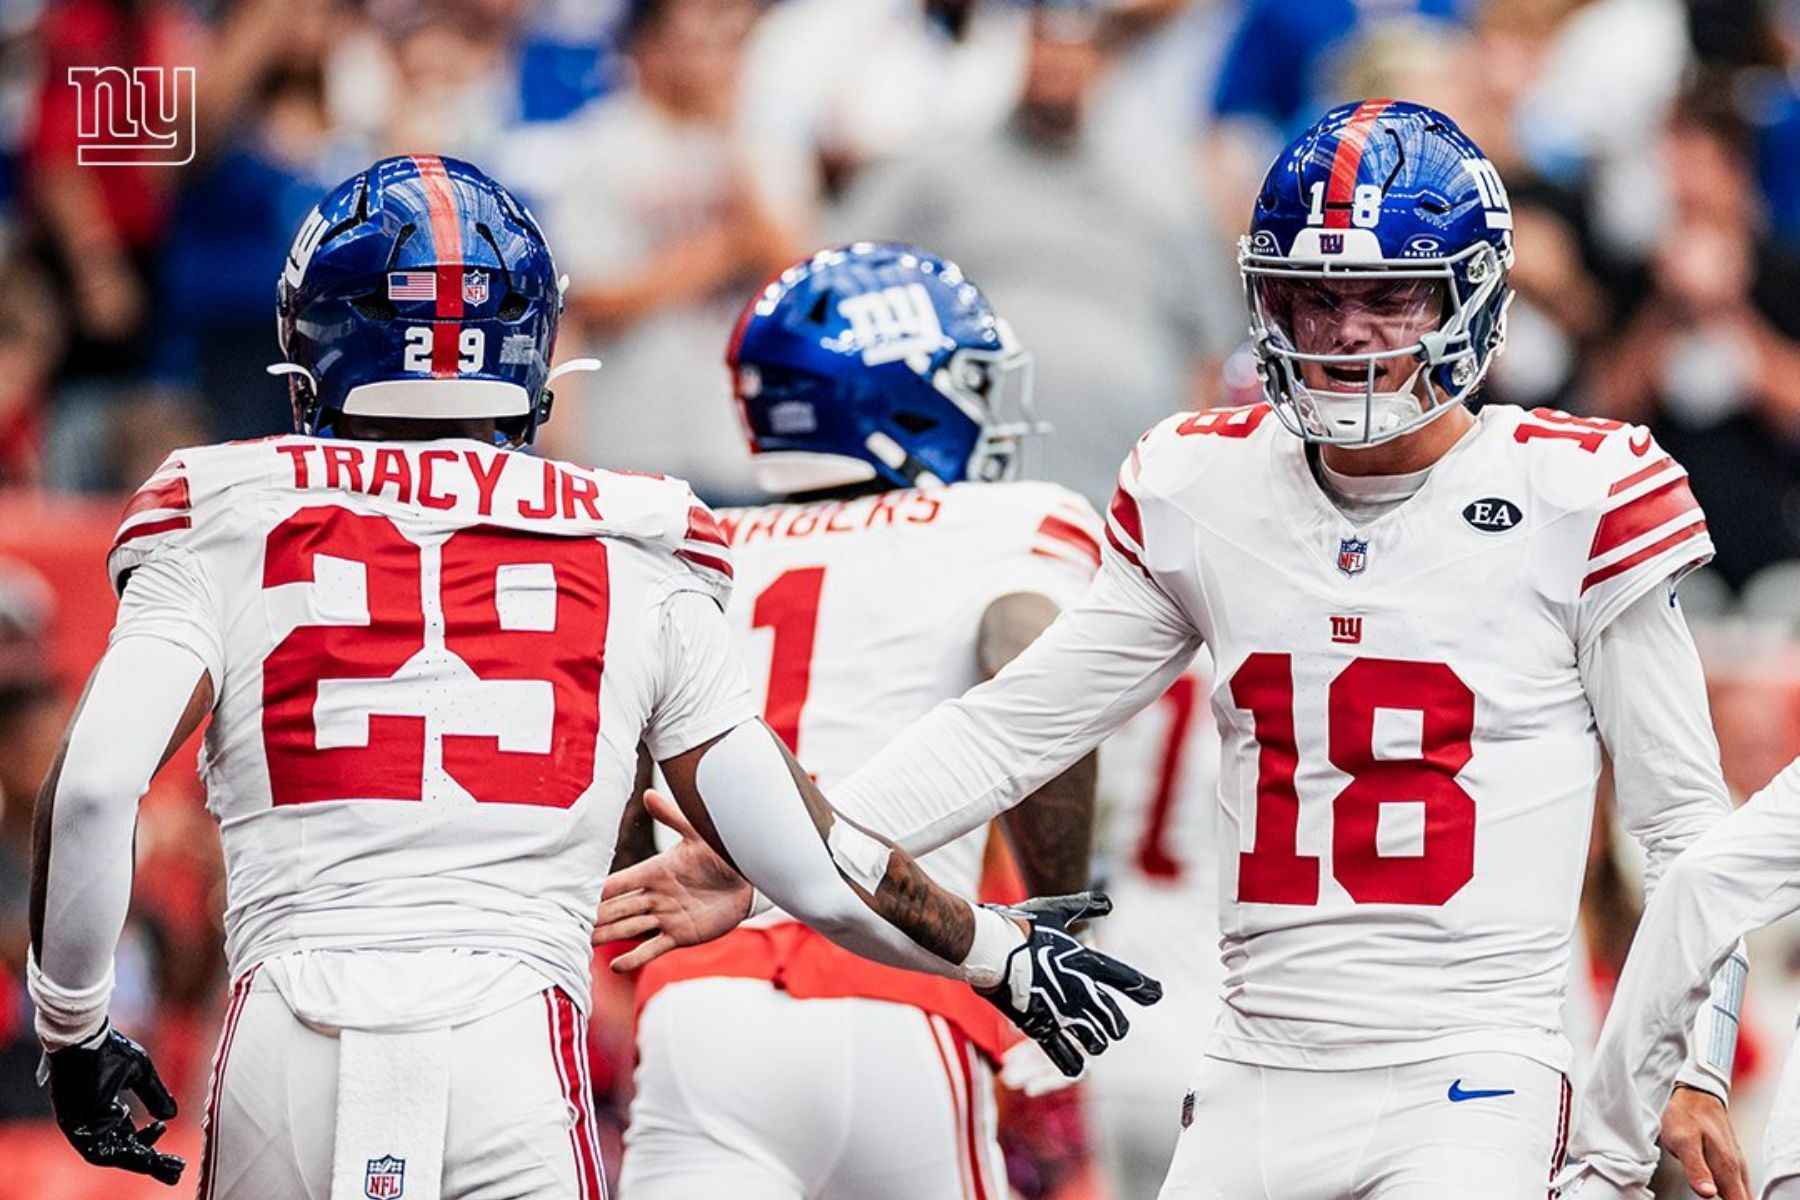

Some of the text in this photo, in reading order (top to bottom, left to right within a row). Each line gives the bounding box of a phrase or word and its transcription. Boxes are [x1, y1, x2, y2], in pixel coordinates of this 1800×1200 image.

[465, 286, 486, 300] NFL
[277, 444, 604, 521] TRACY JR
[1471, 503, 1513, 526] EA
[1340, 553, 1361, 569] NFL
[1329, 616, 1363, 644] ny
[263, 505, 610, 809] 29
[752, 566, 826, 785] 1
[1229, 652, 1476, 906] 18
[369, 1175, 399, 1197] NFL
